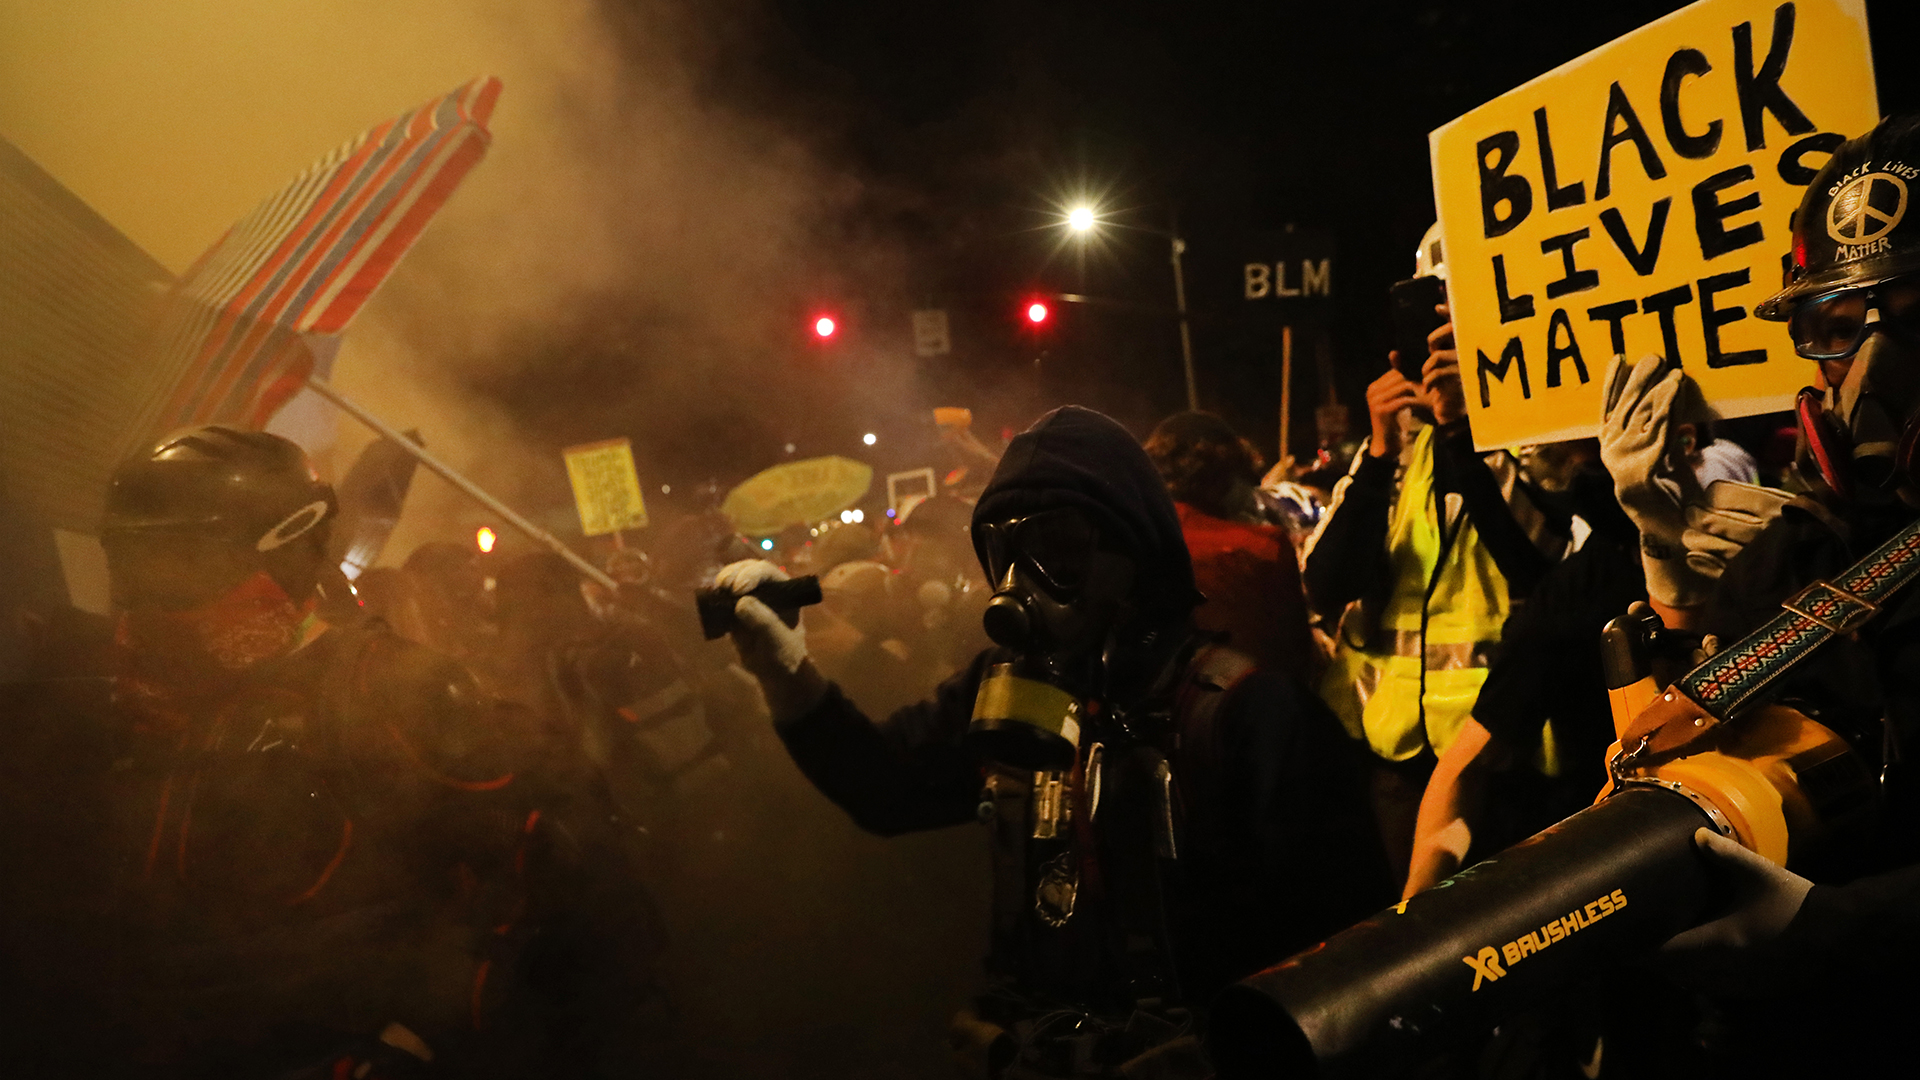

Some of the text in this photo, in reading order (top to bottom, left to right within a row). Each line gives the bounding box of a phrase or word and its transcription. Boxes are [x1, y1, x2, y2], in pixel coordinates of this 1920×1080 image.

[1477, 2, 1817, 239] BLACK
[1244, 258, 1331, 300] BLM
[1477, 252, 1793, 408] MATTE
[1463, 889, 1628, 992] XR BRUSHLESS
